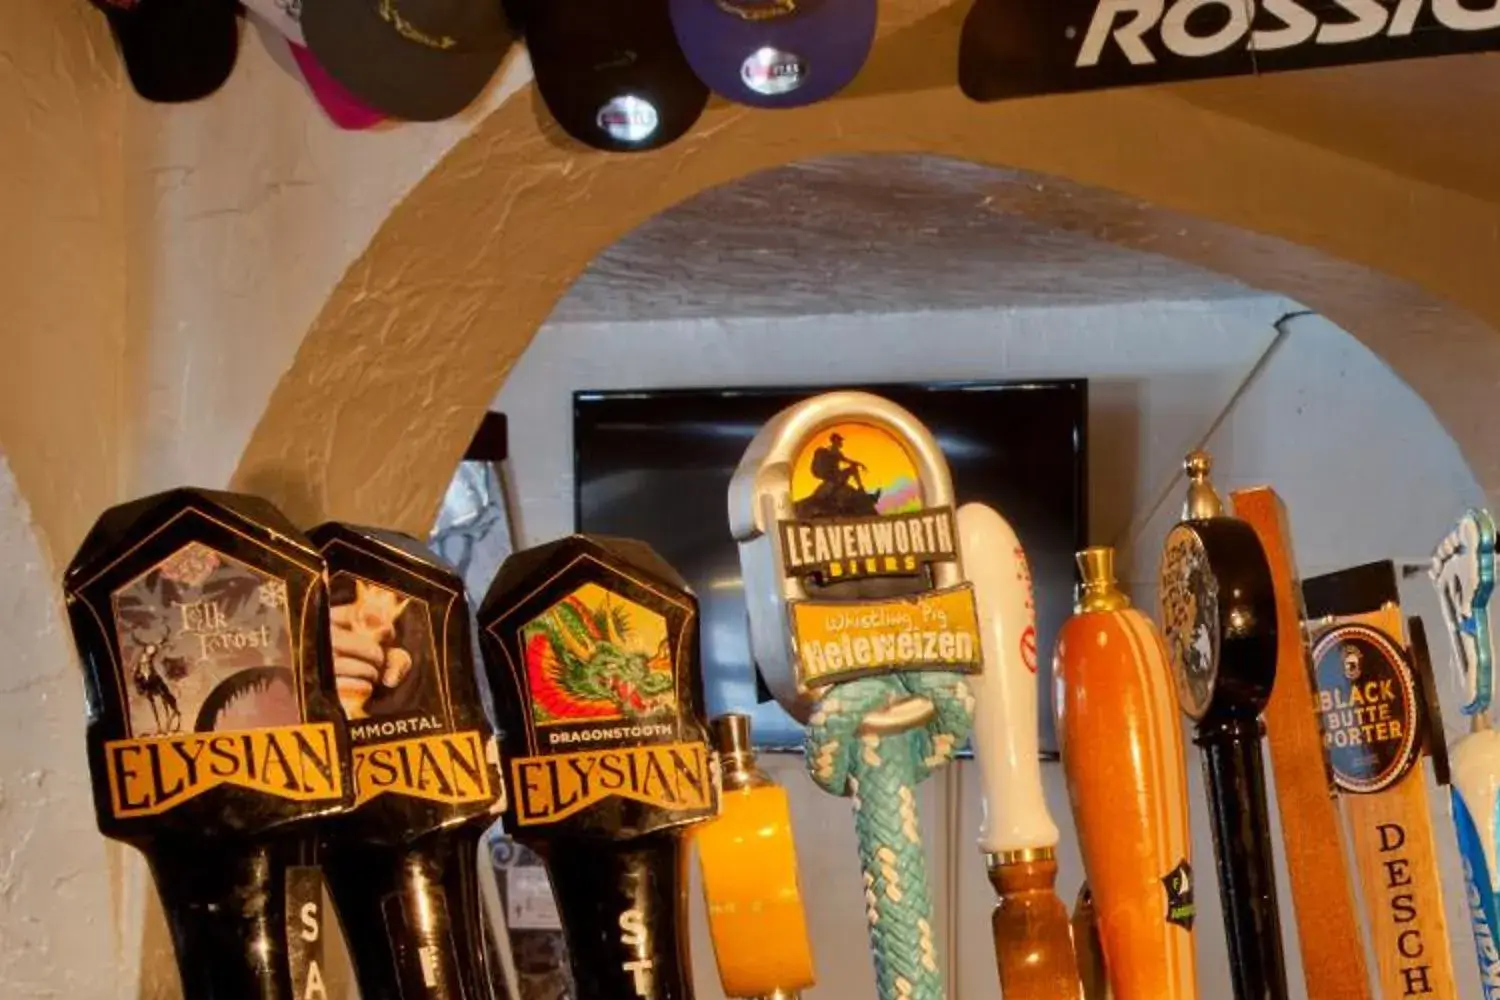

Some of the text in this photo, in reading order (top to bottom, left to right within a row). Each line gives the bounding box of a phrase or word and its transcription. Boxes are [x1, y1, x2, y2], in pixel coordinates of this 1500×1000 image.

[786, 513, 953, 567] LEAVENWORTH
[171, 599, 228, 635] Elk
[826, 602, 948, 633] Whistling Pig
[193, 623, 271, 661] Frost
[1319, 679, 1396, 711] BLACK
[351, 715, 443, 741] MMORTAL
[1327, 703, 1391, 730] BUTTE
[549, 723, 673, 745] DRAGONSTOOTH
[112, 728, 338, 811] ELYSIAN
[518, 744, 710, 819] ELYSIAN
